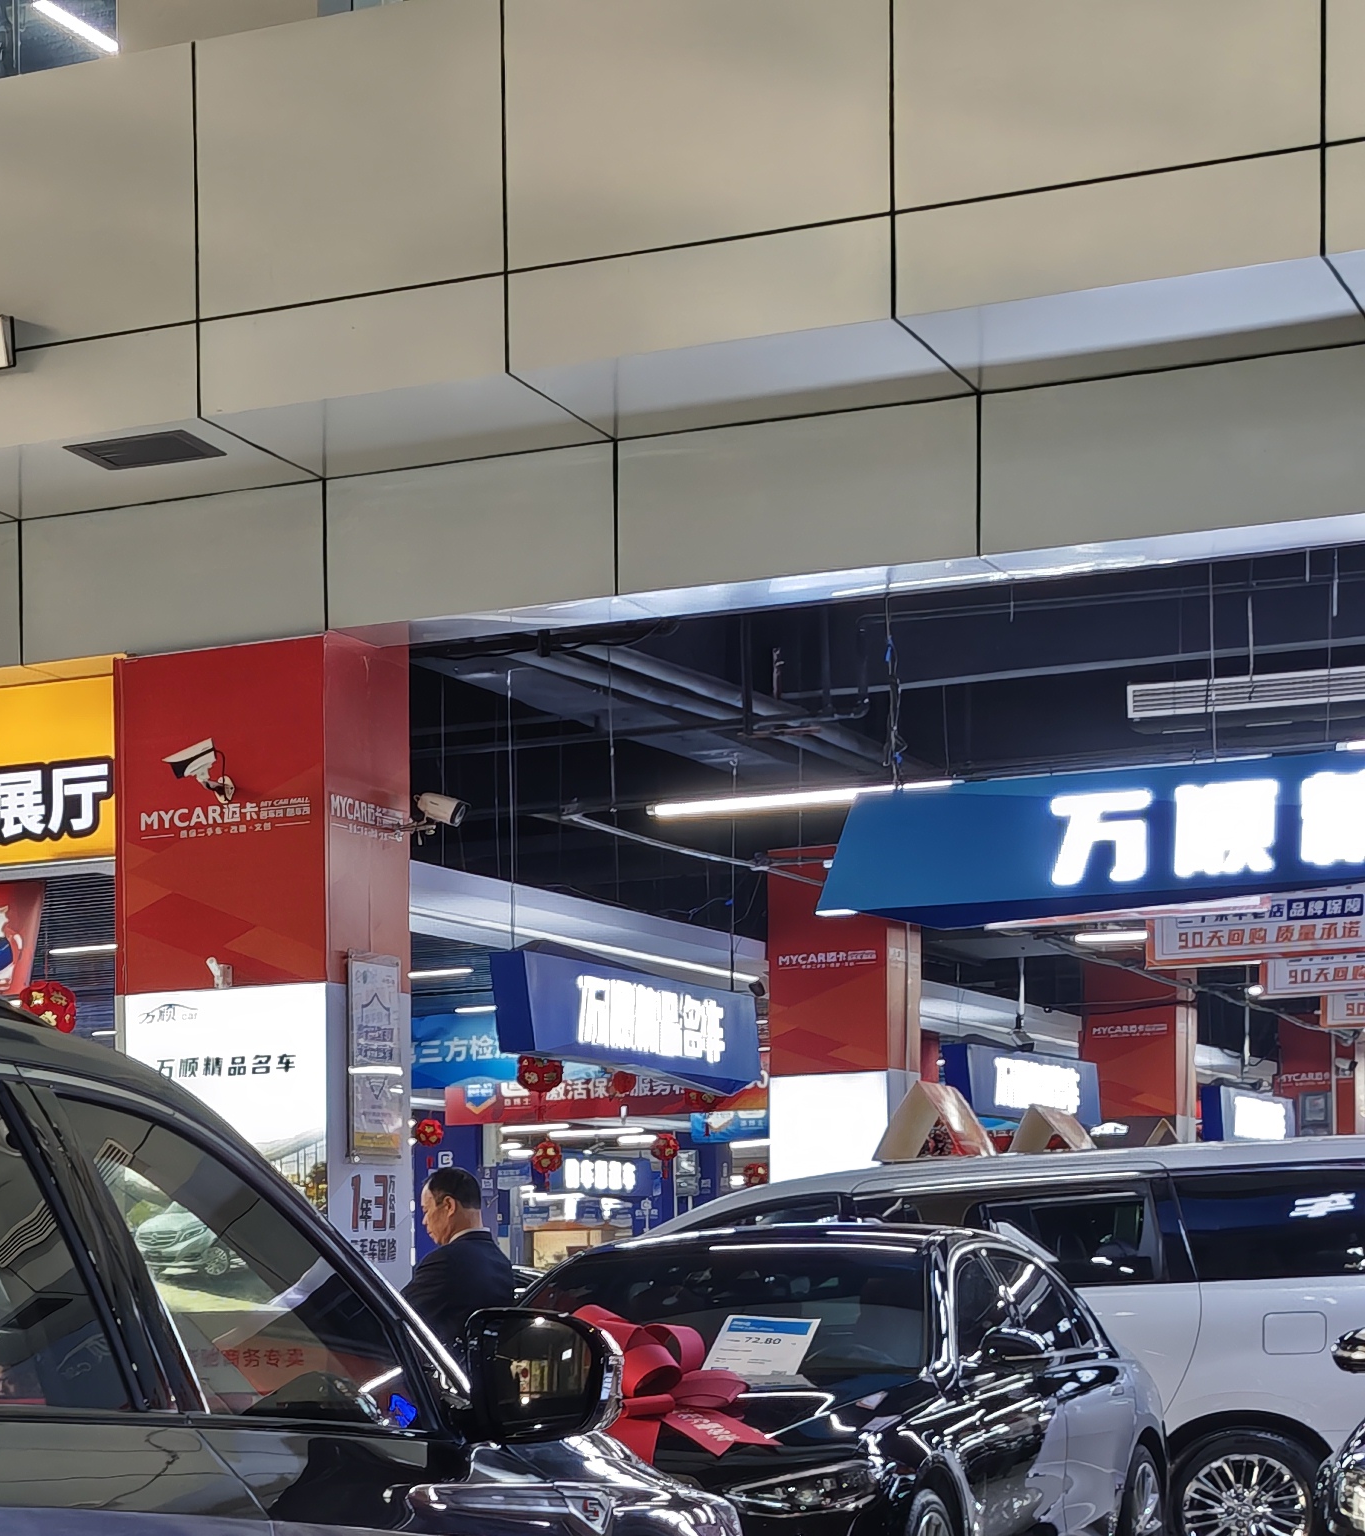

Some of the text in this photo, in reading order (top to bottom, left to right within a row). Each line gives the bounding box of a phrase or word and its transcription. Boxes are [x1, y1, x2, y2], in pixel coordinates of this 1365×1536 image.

[140, 801, 259, 831] MYCAR迈卡
[1289, 897, 1362, 917] 品牌保障
[1178, 921, 1362, 950] 90天回购 质量承诺
[156, 1053, 297, 1078] 万顺精品名车
